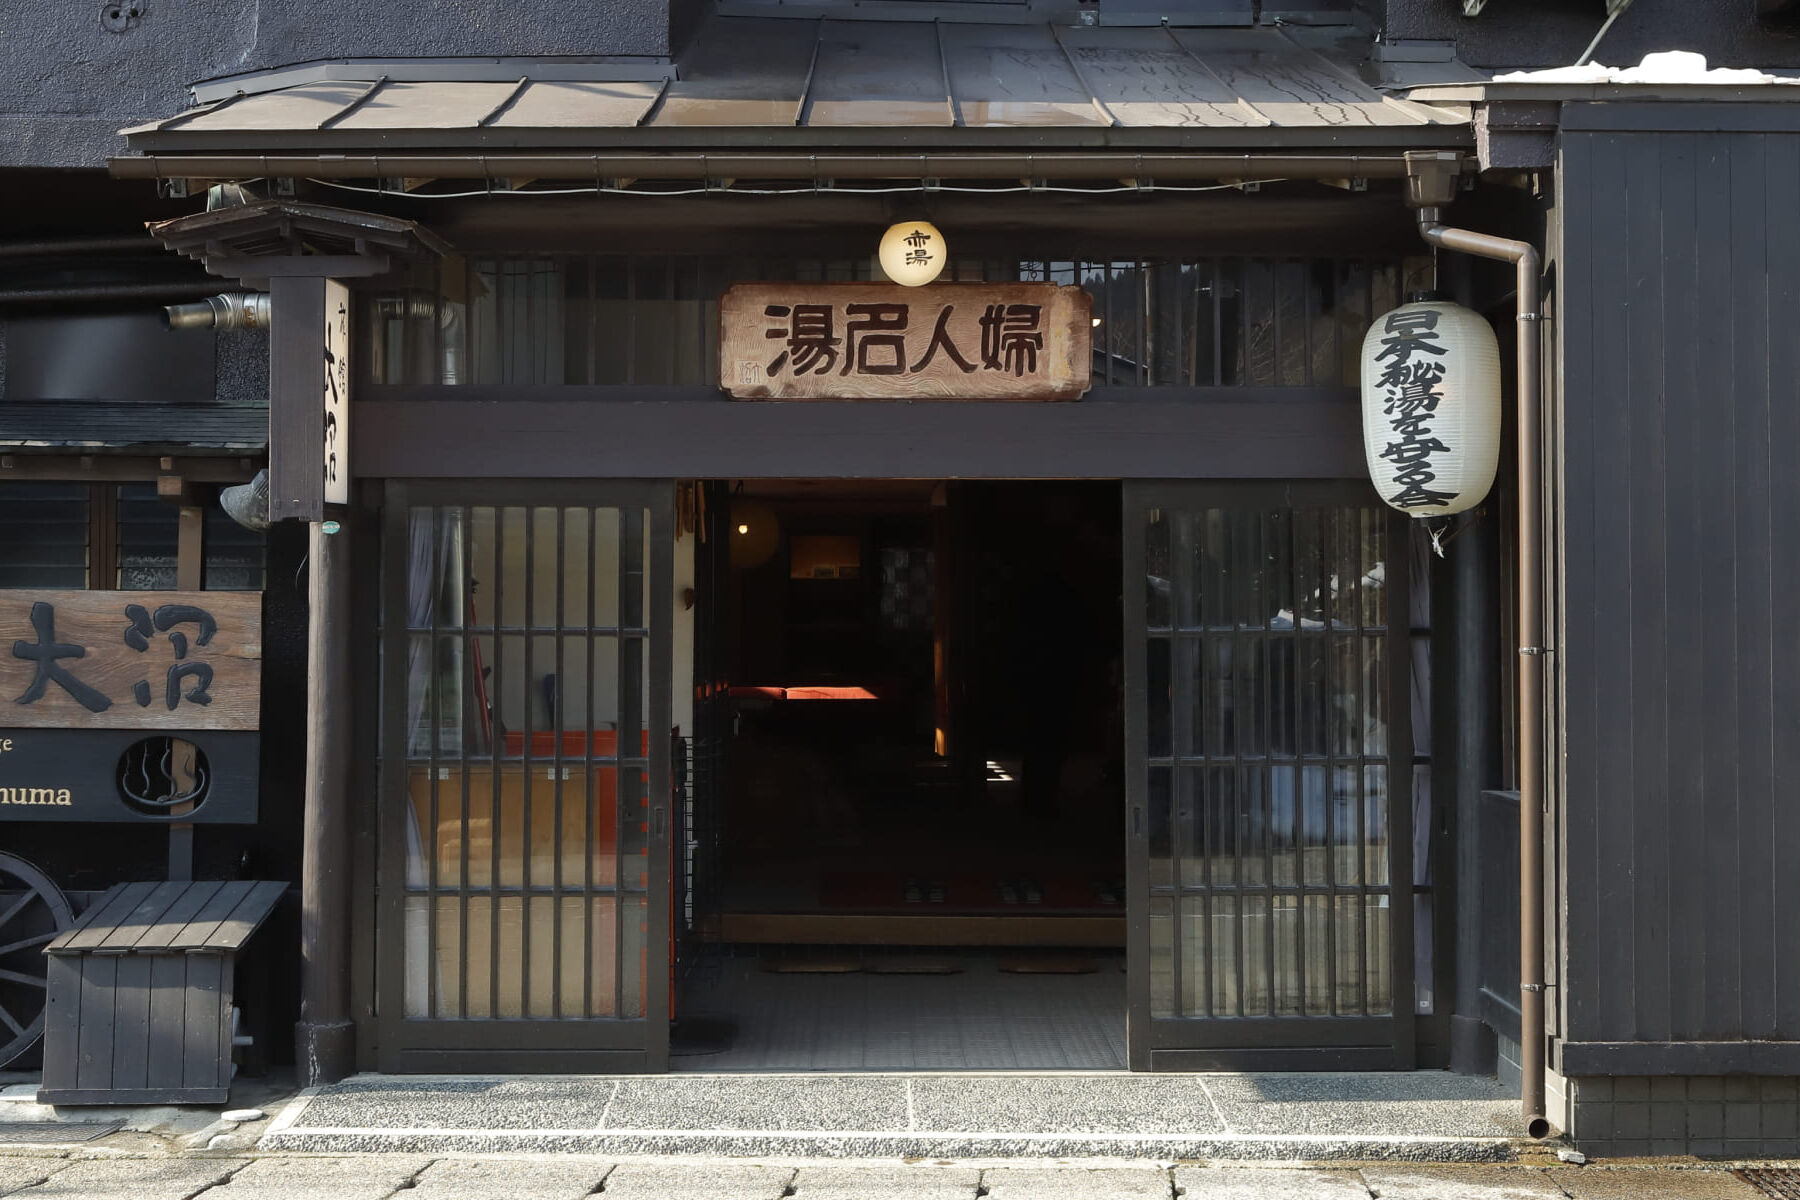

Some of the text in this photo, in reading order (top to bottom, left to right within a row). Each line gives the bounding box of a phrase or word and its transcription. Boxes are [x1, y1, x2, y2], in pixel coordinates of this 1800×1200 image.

[903, 229, 933, 267] 赤湯
[1374, 309, 1461, 509] 日本秘湯を守る会
[12, 601, 218, 713] 大沼
